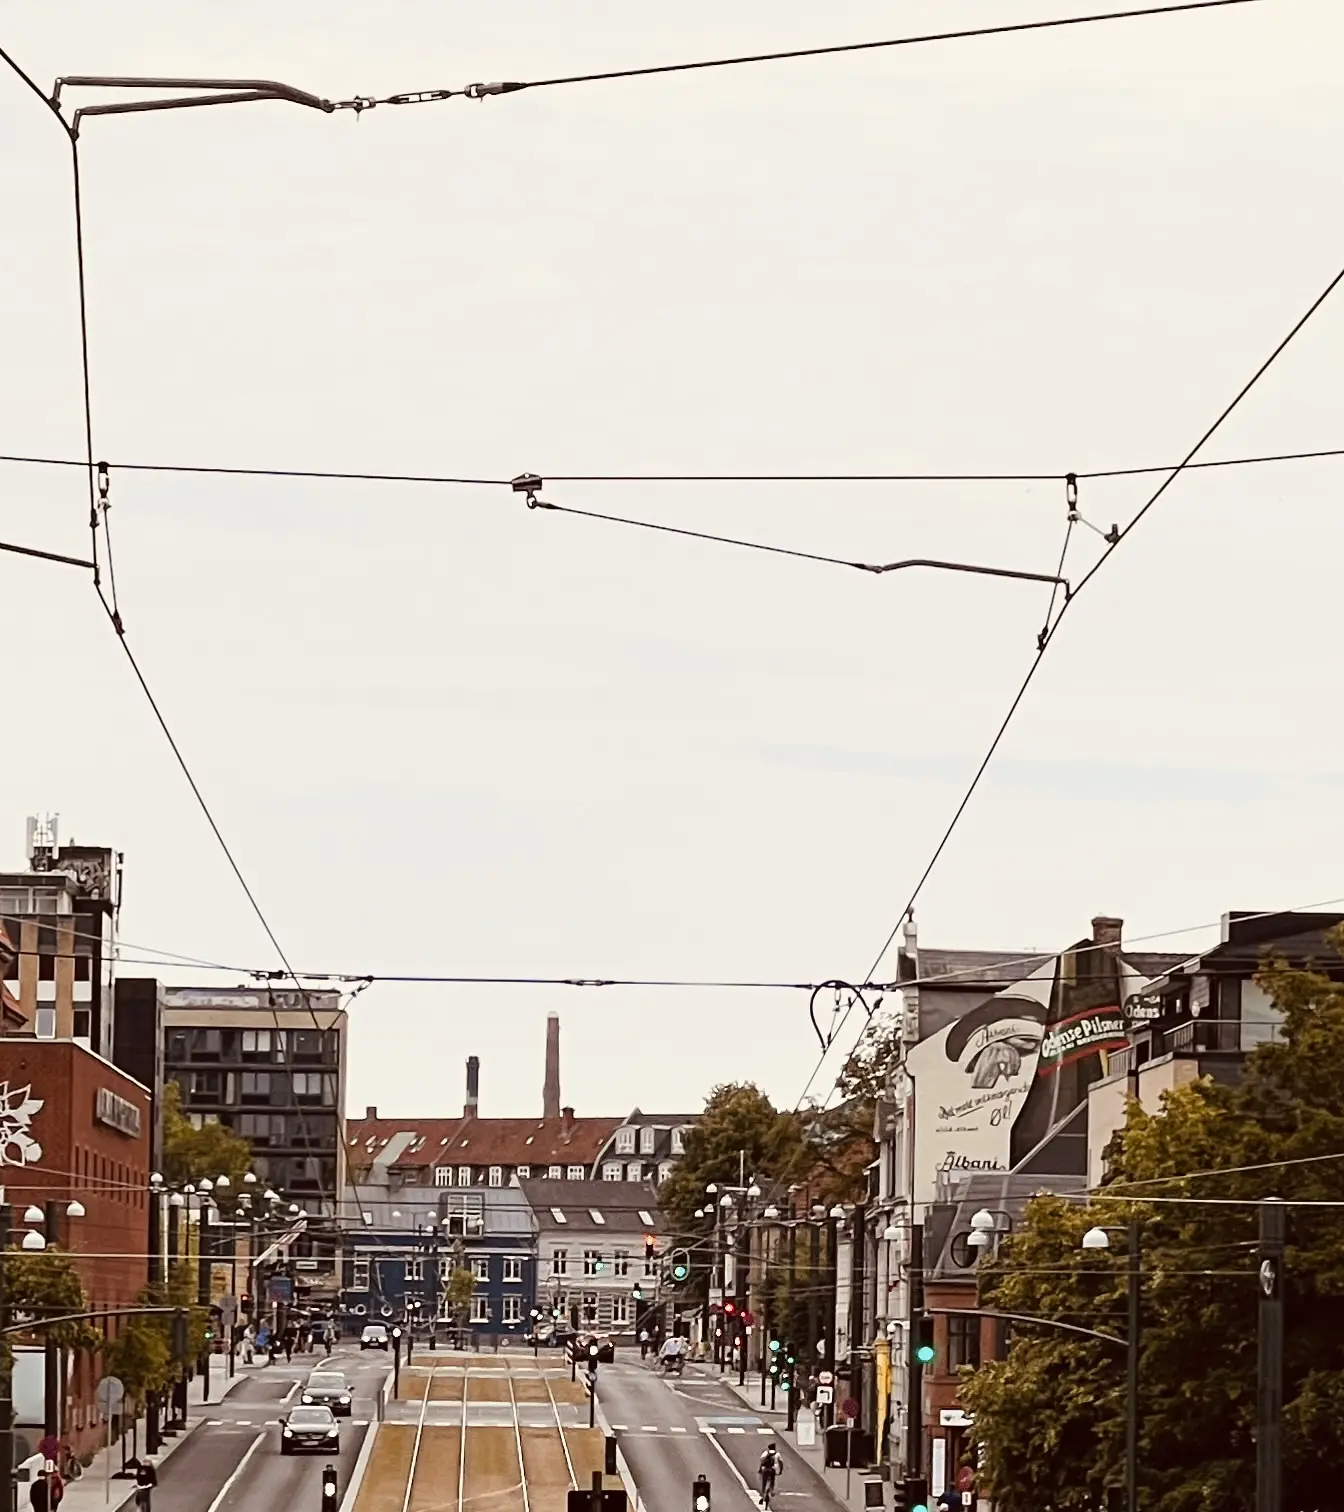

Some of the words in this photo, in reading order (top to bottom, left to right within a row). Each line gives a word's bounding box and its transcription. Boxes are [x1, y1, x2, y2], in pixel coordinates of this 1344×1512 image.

[1041, 1025, 1083, 1058] Odense
[1080, 1016, 1125, 1037] Pilsner
[936, 1151, 1006, 1173] Albani
